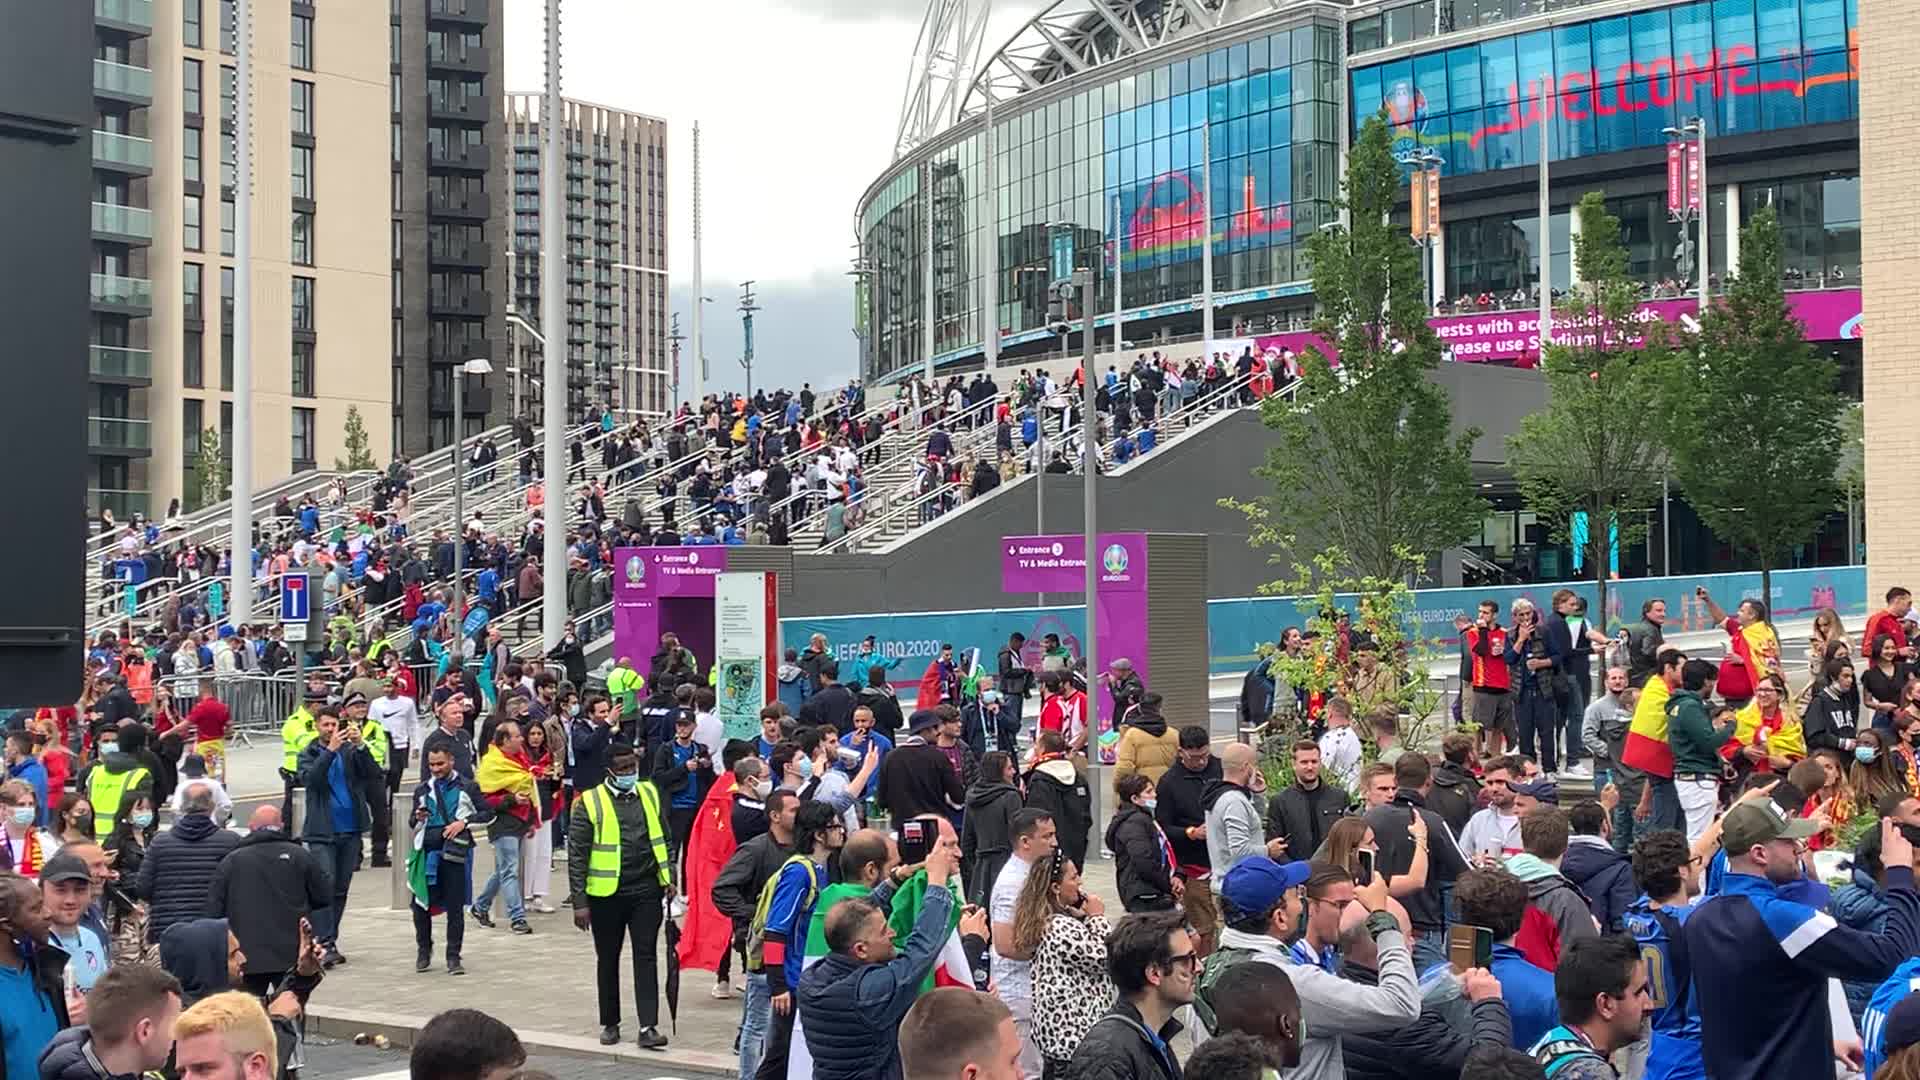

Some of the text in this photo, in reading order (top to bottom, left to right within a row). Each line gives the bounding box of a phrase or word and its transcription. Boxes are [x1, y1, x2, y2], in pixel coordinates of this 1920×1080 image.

[1507, 43, 1757, 126] WELCOME
[1477, 318, 1513, 334] with
[1496, 339, 1524, 352] use
[1019, 546, 1051, 555] Entrance
[1019, 560, 1029, 568] TV
[1037, 559, 1059, 567] Media
